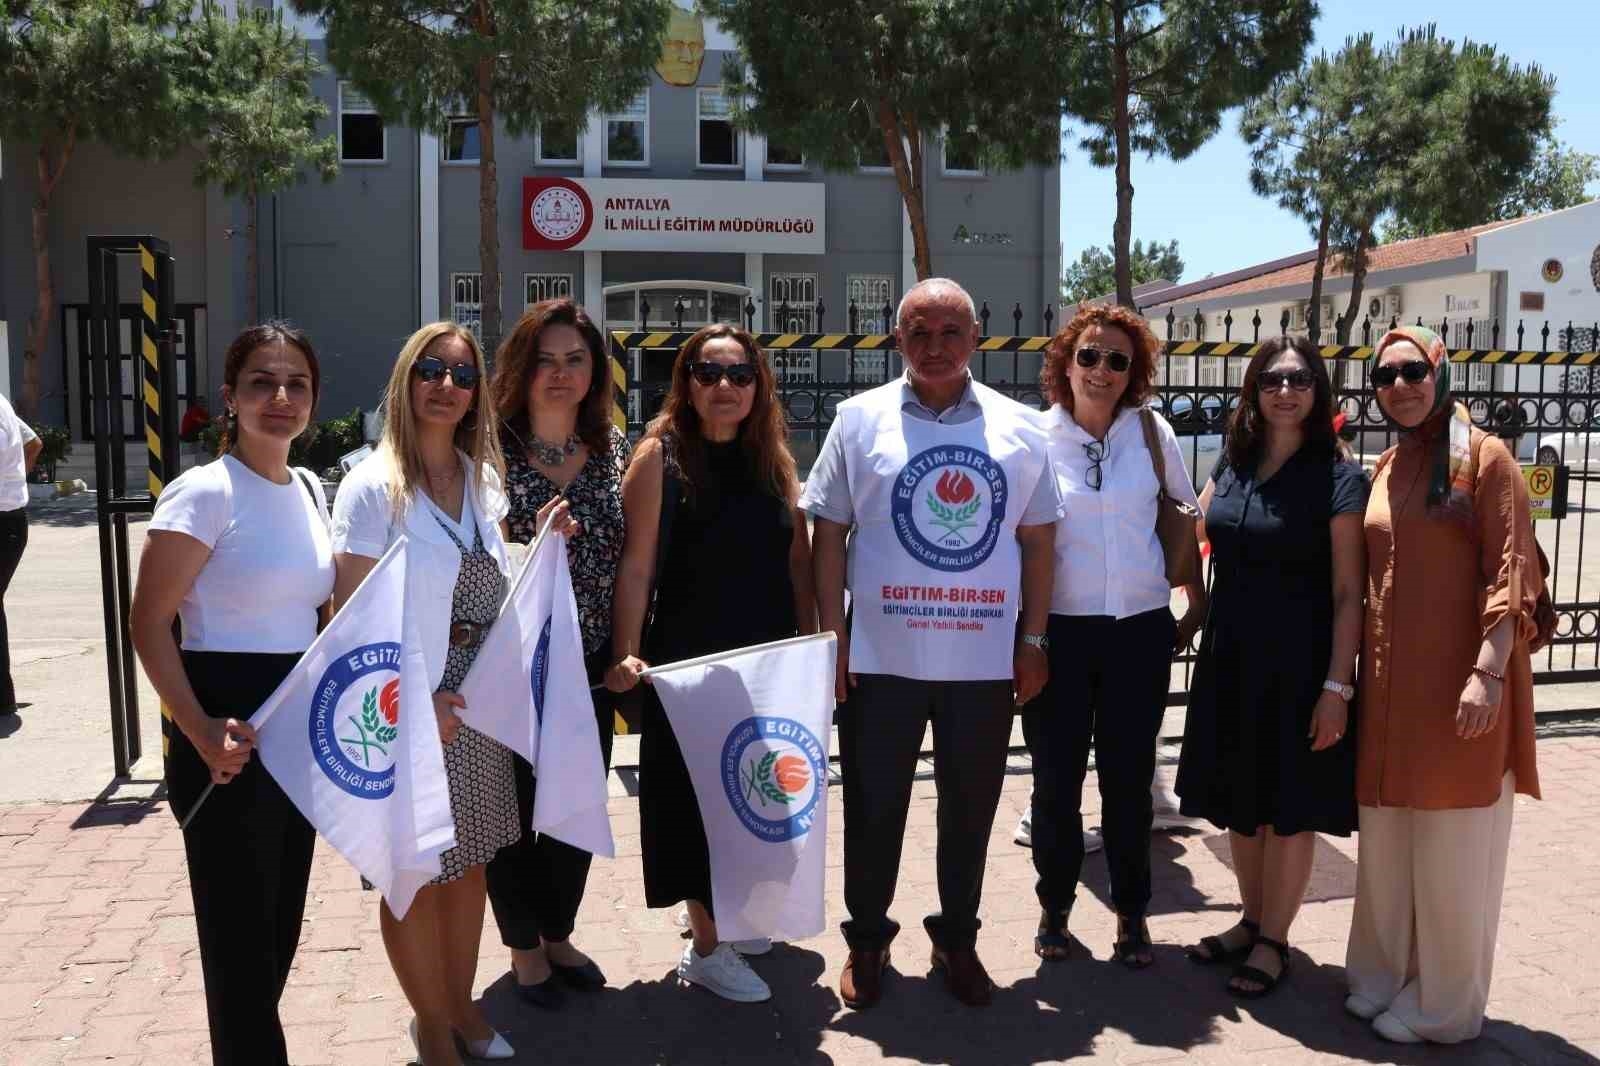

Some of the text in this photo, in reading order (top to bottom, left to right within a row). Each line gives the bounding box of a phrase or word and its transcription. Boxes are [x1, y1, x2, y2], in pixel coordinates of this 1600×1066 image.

[604, 198, 670, 212] ANTALYA
[604, 215, 814, 234] İL MİLLİ EĞİTİM MÜDÜRLÜĞÜ
